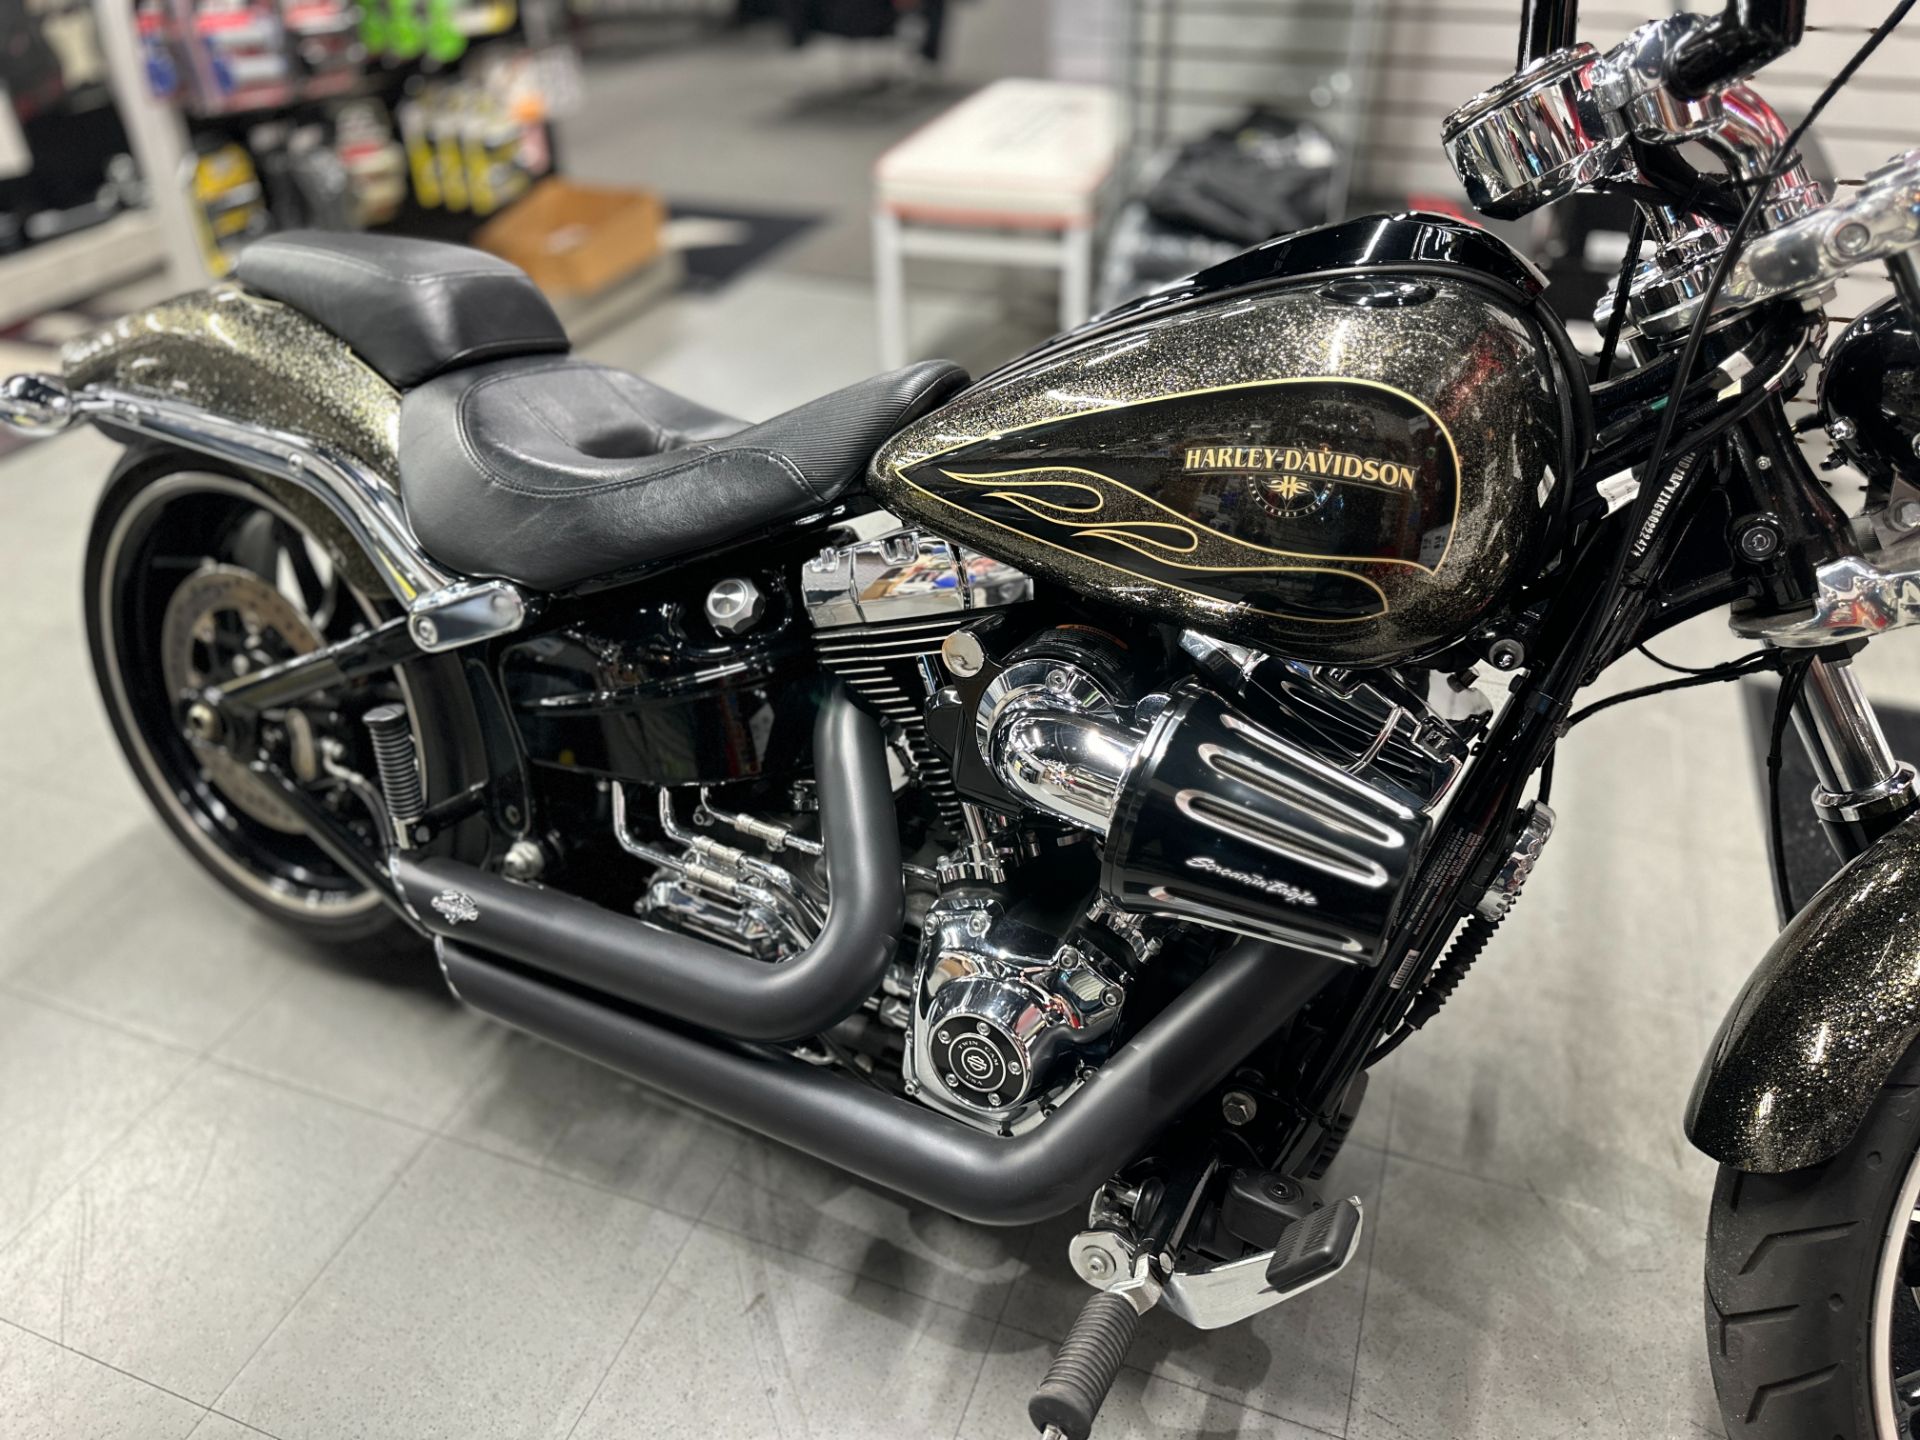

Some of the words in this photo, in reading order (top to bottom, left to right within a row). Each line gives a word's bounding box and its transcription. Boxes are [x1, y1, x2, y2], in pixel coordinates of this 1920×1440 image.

[1185, 448, 1416, 491] HARLEY-DAVIDSON
[958, 1040, 978, 1050] TWIN
[984, 1046, 999, 1066] CAM
[965, 1074, 983, 1086] USA
